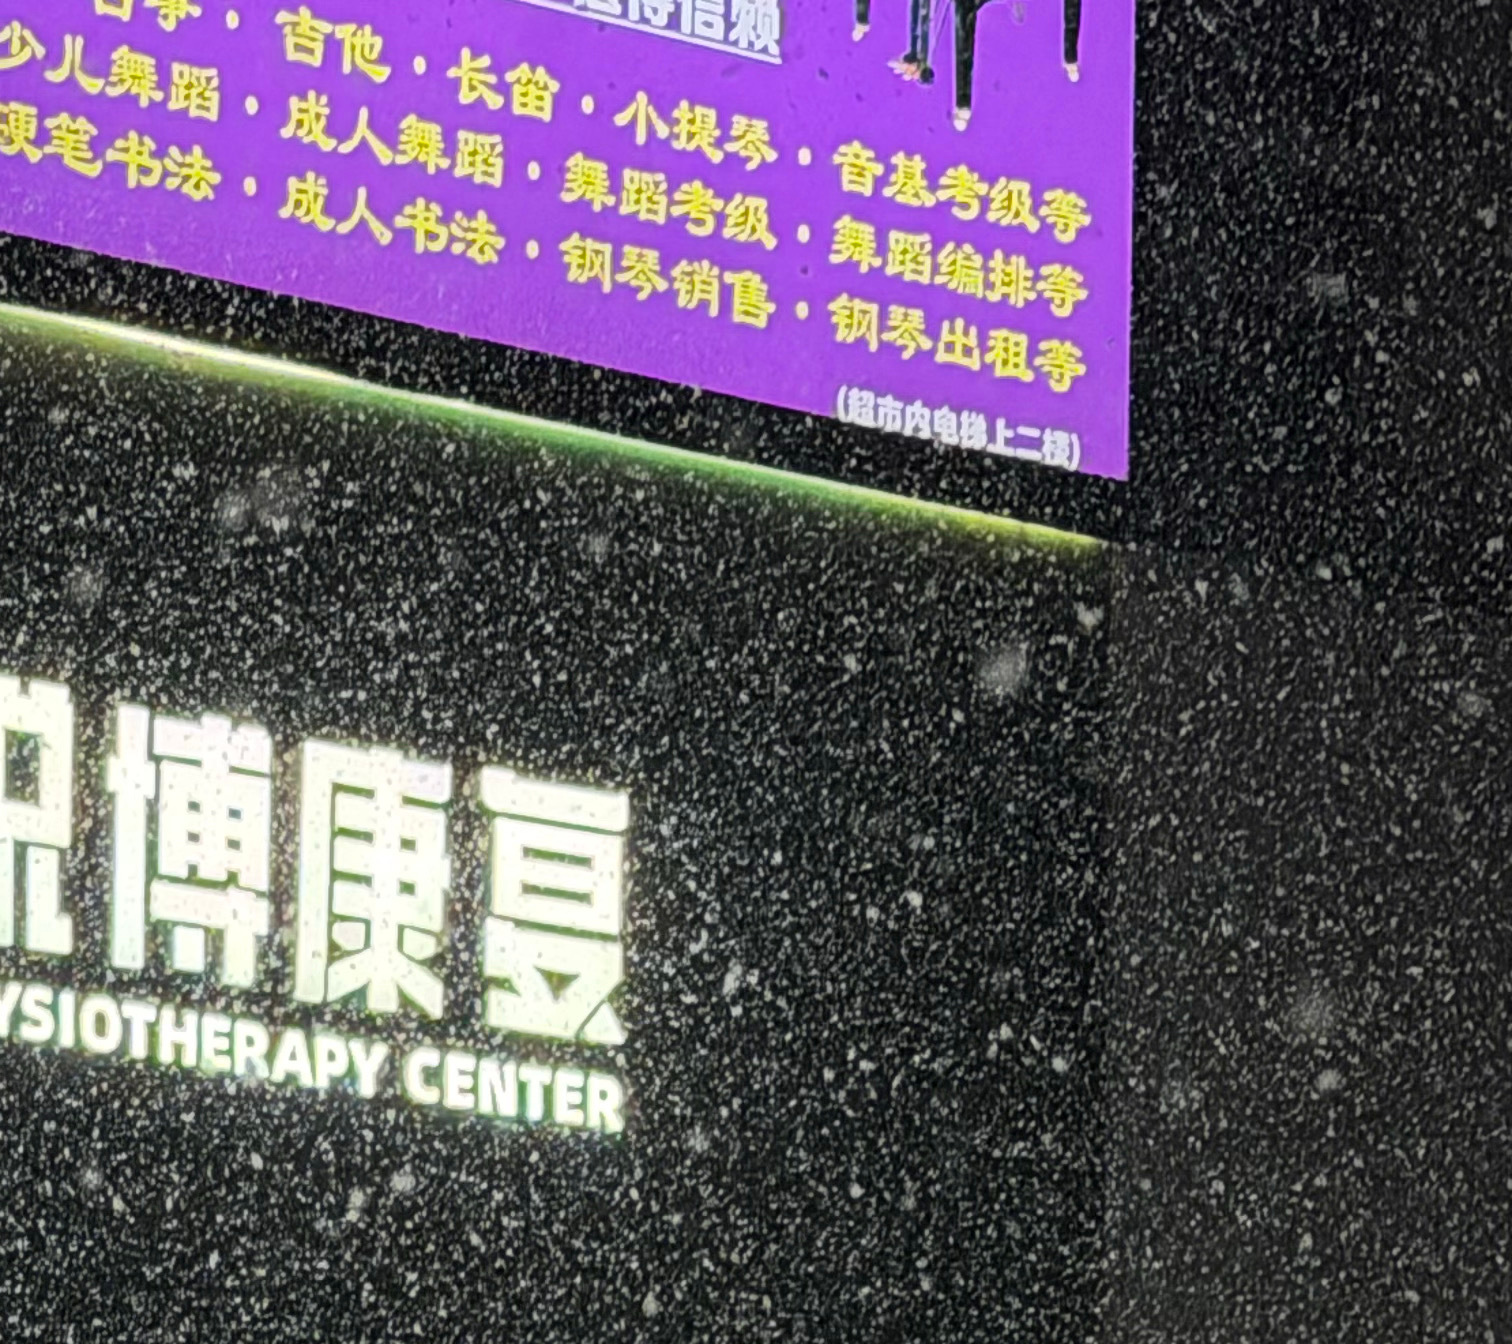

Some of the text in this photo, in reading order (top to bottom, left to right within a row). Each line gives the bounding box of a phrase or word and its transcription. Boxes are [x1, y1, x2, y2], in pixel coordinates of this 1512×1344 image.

[275, 6, 392, 83] 吉他
[447, 47, 561, 122] 长笛
[614, 91, 779, 170] 小提琴
[832, 140, 1091, 243] 音基考级等
[279, 90, 504, 189] 成人舞蹈
[559, 152, 778, 251] 舞蹈考级
[829, 215, 1088, 318] 舞蹈编排等
[277, 171, 506, 265] 成人书法
[559, 232, 777, 329] 钢琴销售
[827, 293, 1087, 393] 钢琴出租等
[402, 1045, 626, 1134] CENTER
